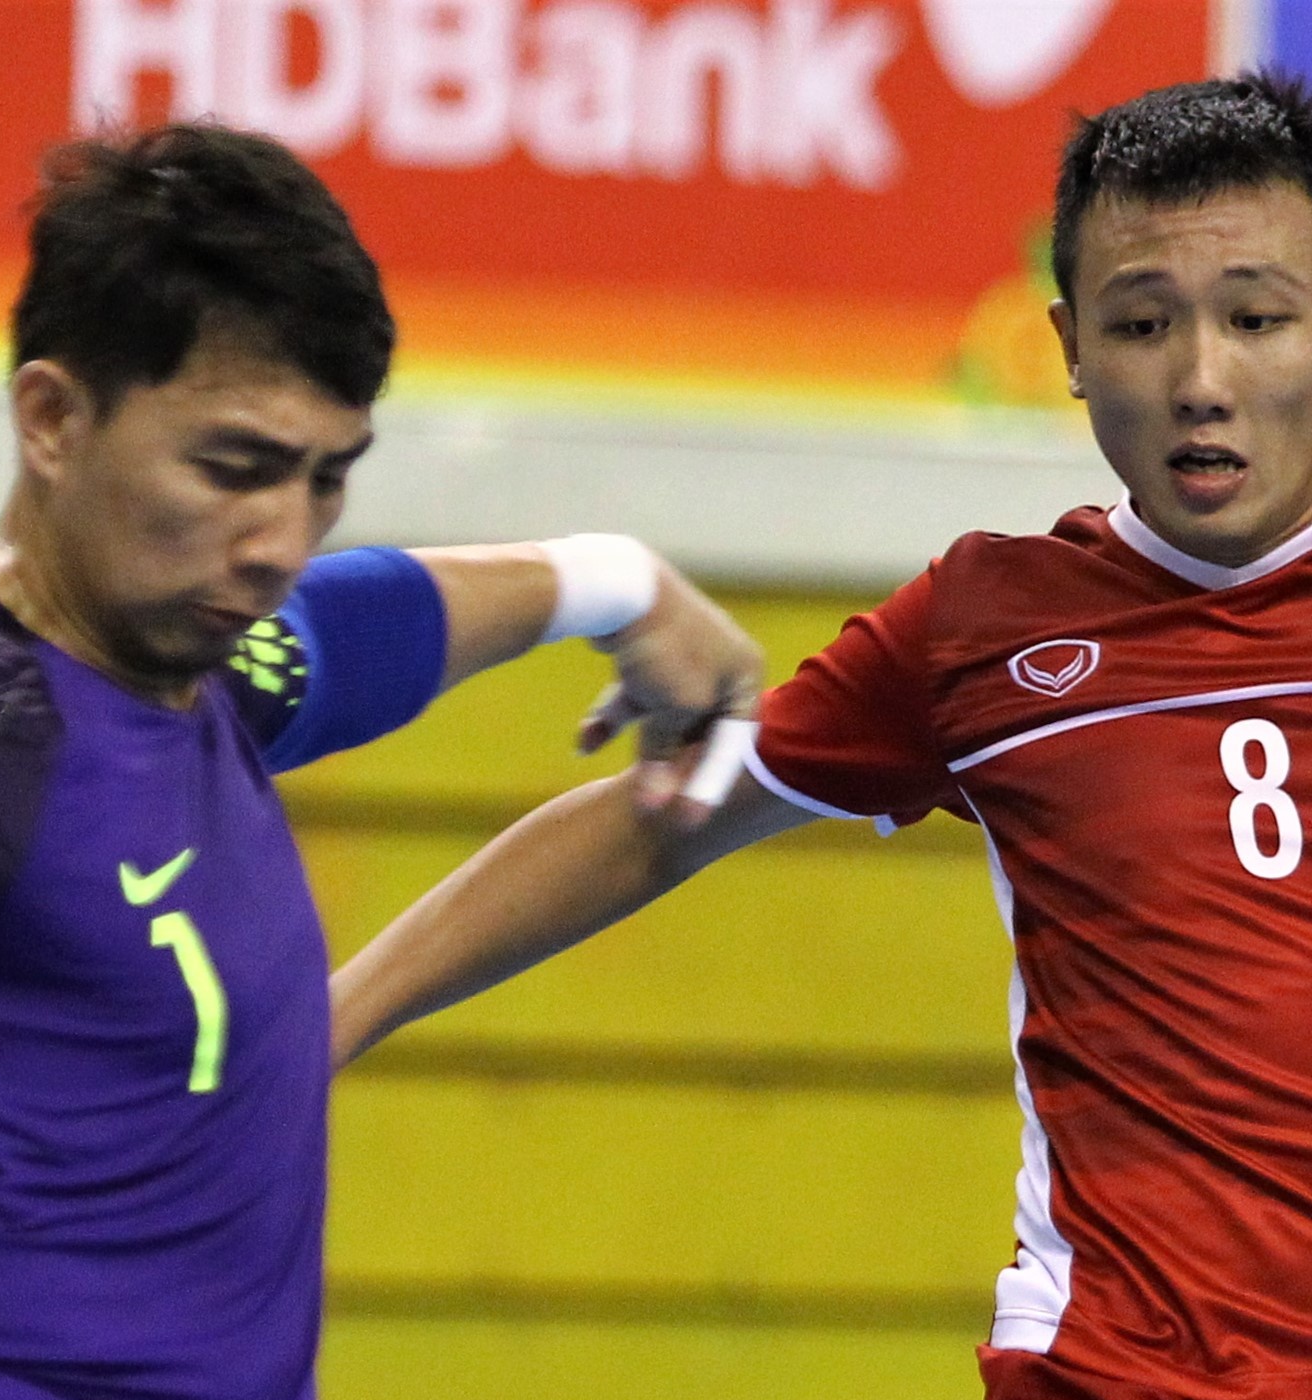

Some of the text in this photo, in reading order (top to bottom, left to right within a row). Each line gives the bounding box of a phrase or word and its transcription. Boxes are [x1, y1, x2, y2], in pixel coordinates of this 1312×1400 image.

[73, 0, 903, 188] HDBank
[1218, 718, 1304, 880] 8
[149, 907, 229, 1093] 1
